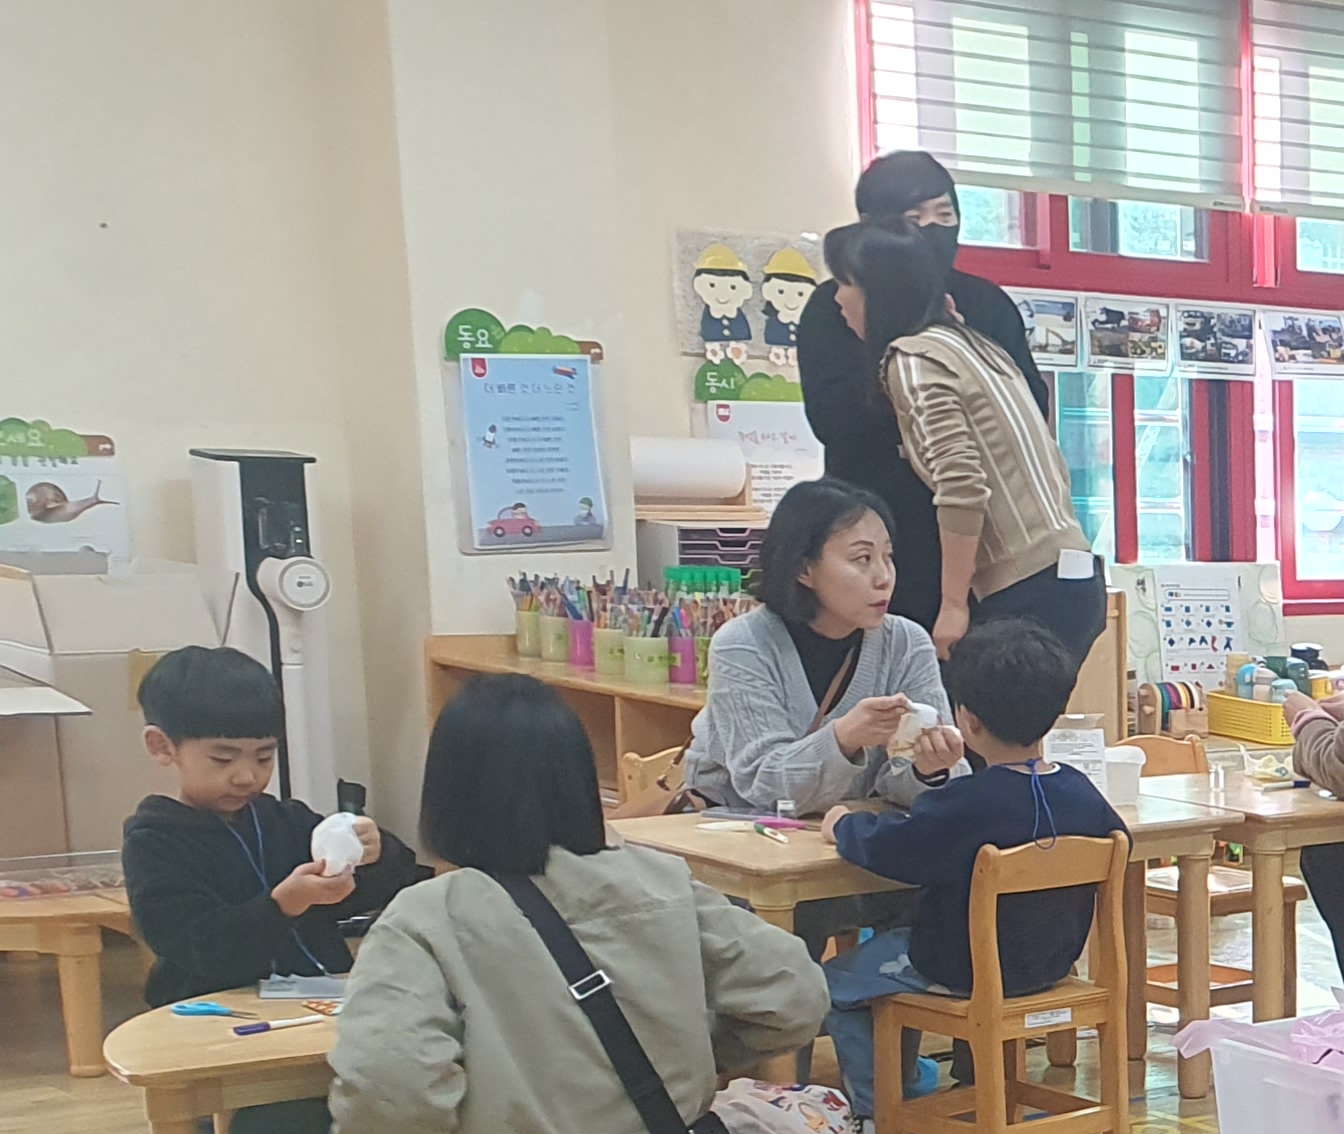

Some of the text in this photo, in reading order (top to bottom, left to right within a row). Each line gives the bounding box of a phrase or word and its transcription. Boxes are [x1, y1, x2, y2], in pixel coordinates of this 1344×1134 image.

[457, 324, 493, 350] 동요
[705, 371, 735, 393] 동시
[0, 429, 45, 447] 세요
